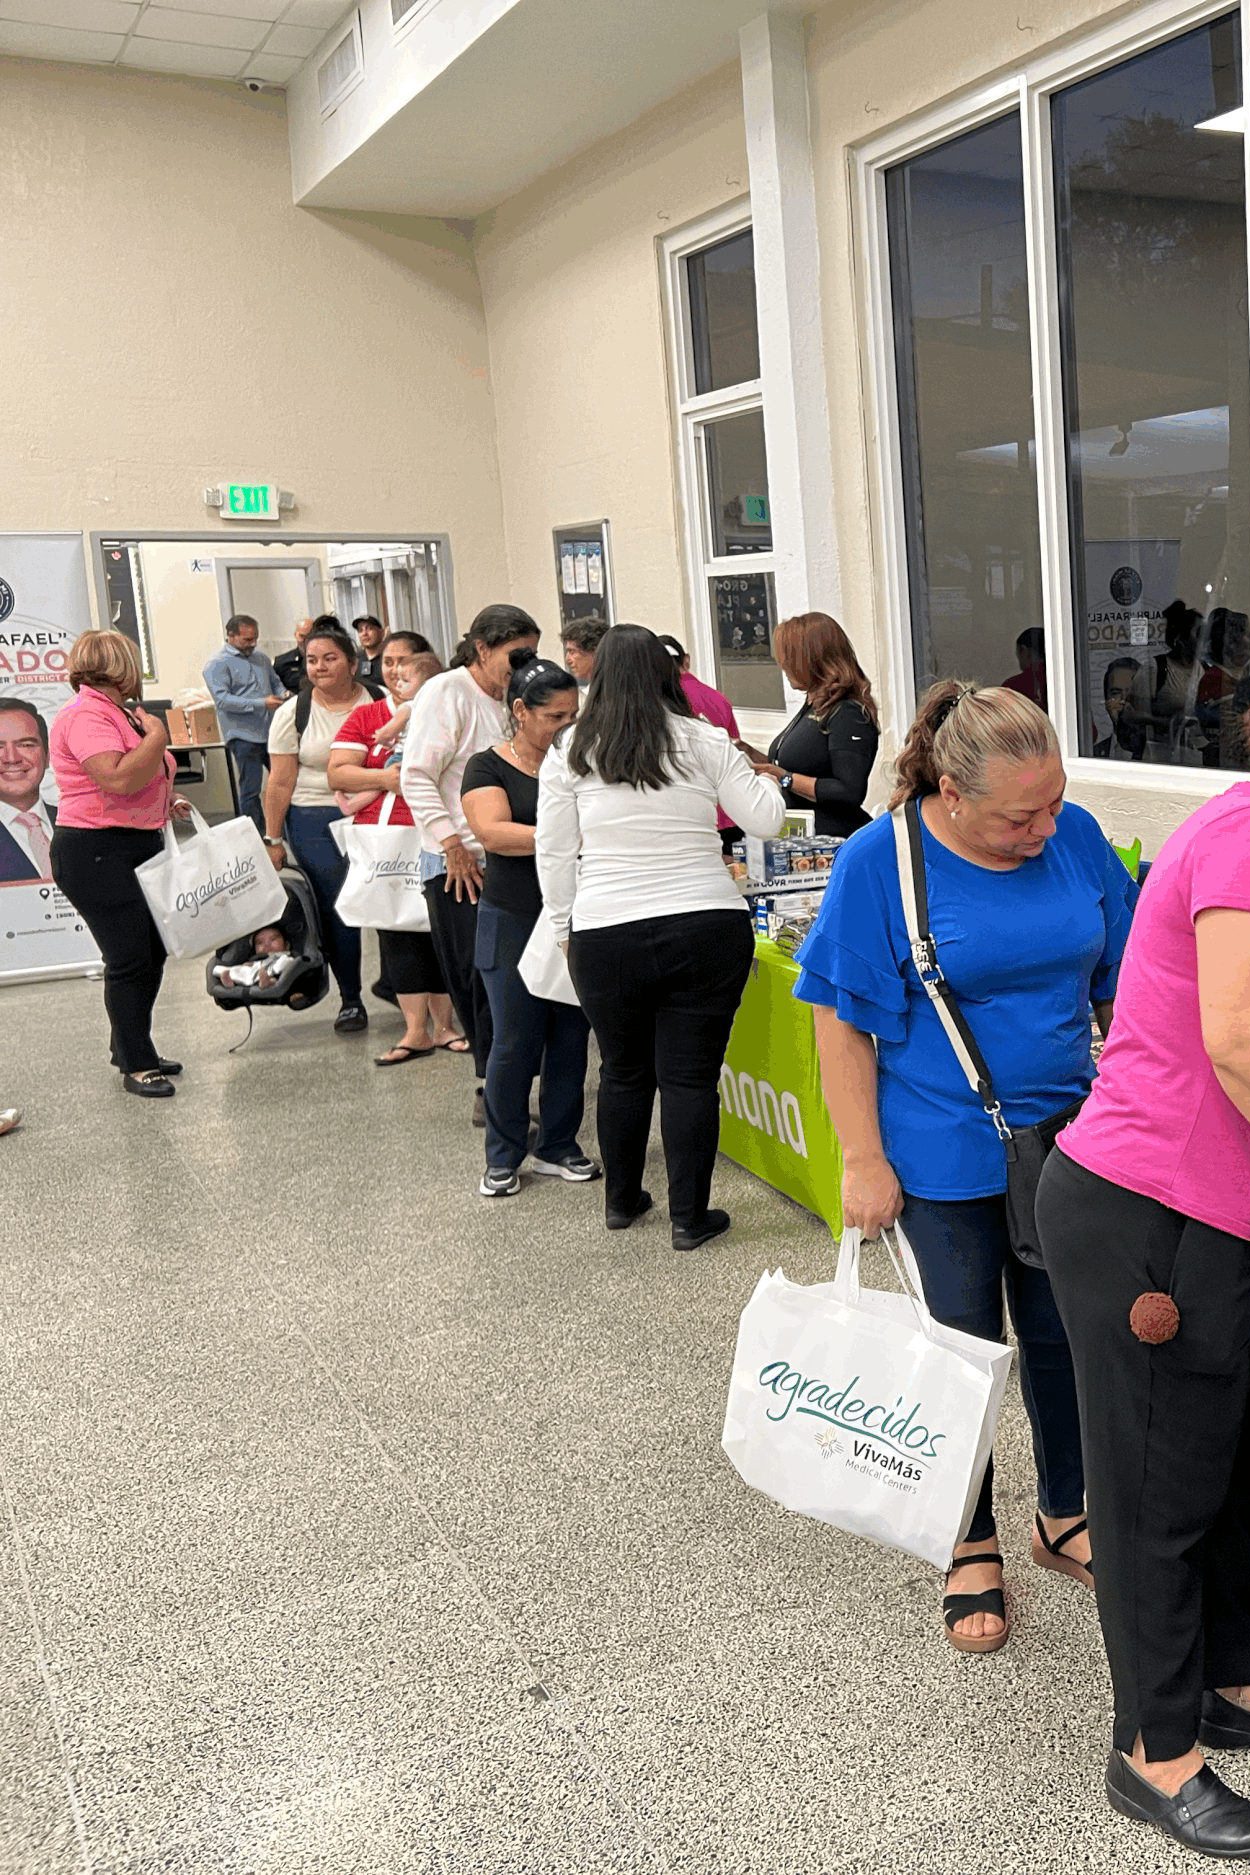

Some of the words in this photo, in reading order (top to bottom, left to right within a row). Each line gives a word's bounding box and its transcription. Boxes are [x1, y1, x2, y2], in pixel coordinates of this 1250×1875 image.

[229, 485, 268, 513] EXIT
[17, 675, 61, 683] DISTRICT
[176, 856, 256, 918] agradecidos
[759, 1361, 947, 1457] agradecidos
[844, 1459, 883, 1480] Medical
[882, 1474, 918, 1494] Centers
[853, 1440, 923, 1481] VivaMás
